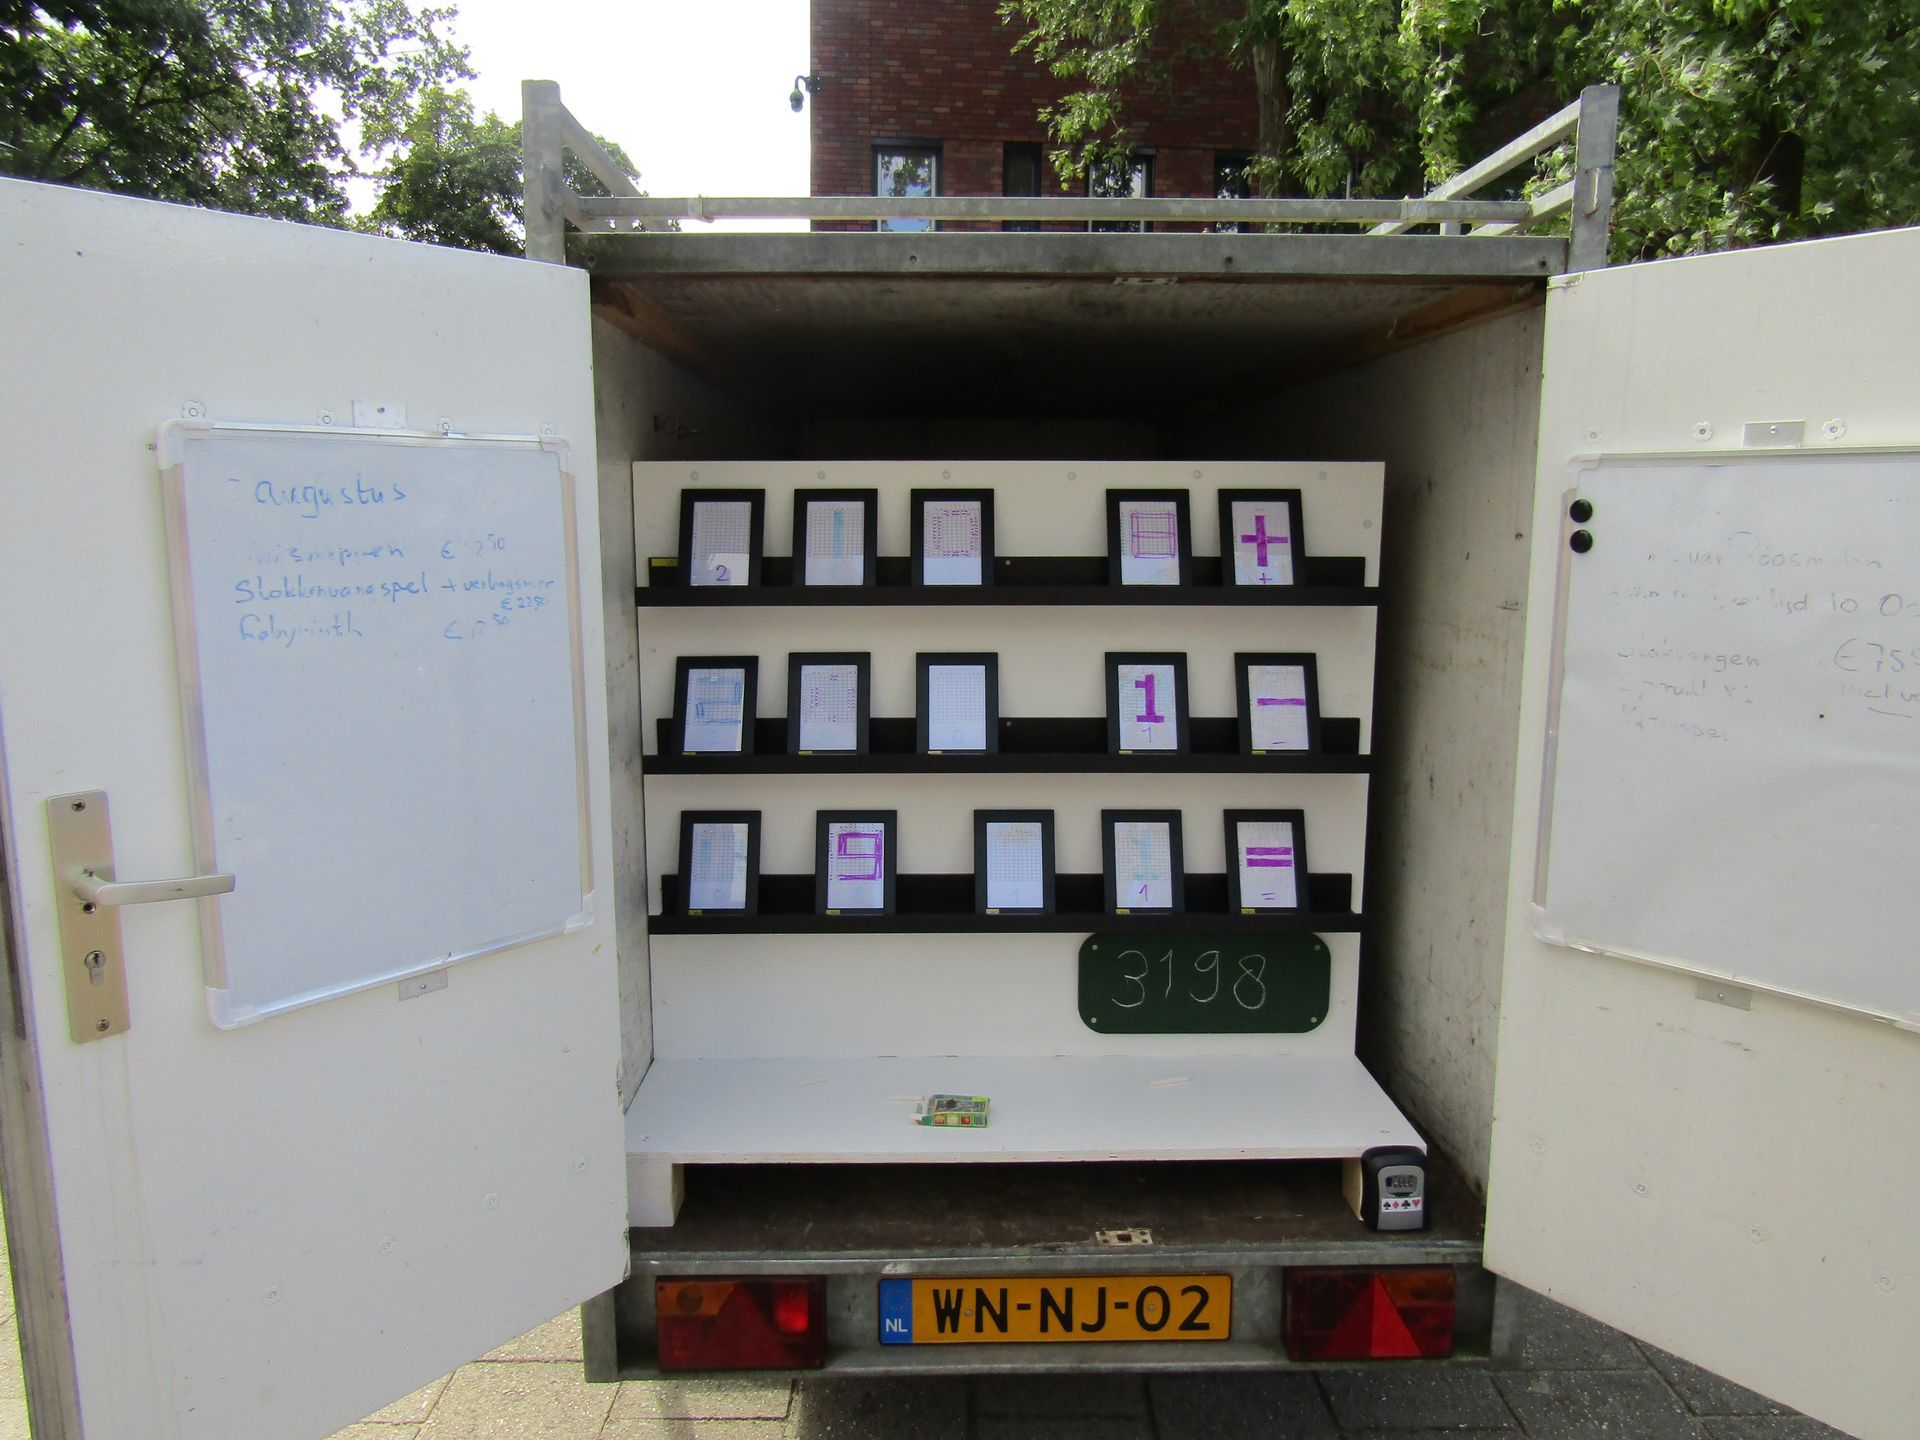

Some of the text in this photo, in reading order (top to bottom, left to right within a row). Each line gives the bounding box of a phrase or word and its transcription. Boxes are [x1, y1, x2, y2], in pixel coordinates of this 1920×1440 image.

[1111, 948, 1267, 1010] 3198
[885, 1285, 1211, 1334] NL WN-NJ-02
